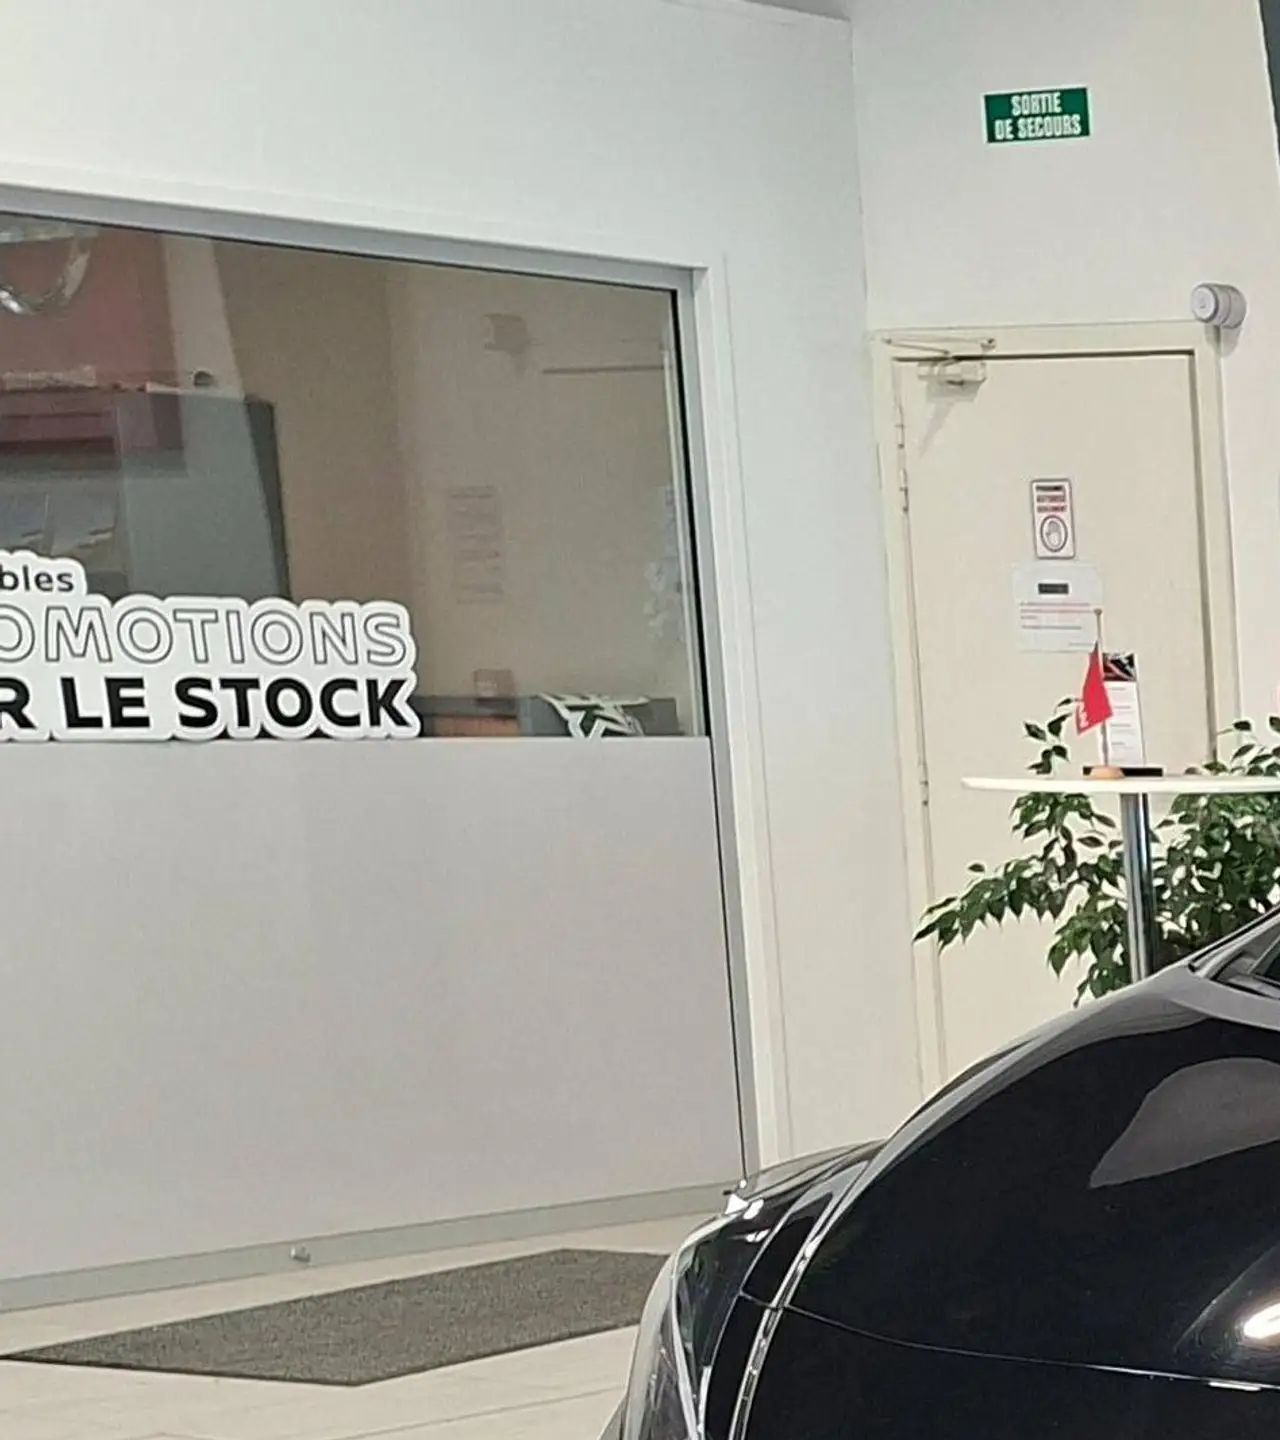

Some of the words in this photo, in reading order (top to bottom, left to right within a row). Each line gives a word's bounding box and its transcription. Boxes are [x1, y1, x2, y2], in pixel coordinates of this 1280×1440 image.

[1011, 92, 1062, 116] SORTIE
[994, 119, 1014, 140] DE
[1017, 114, 1082, 138] SECOURS
[0, 564, 74, 592] bles
[0, 603, 407, 666] OMOTIONS
[60, 677, 151, 729] LE
[174, 677, 411, 729] STOCK
